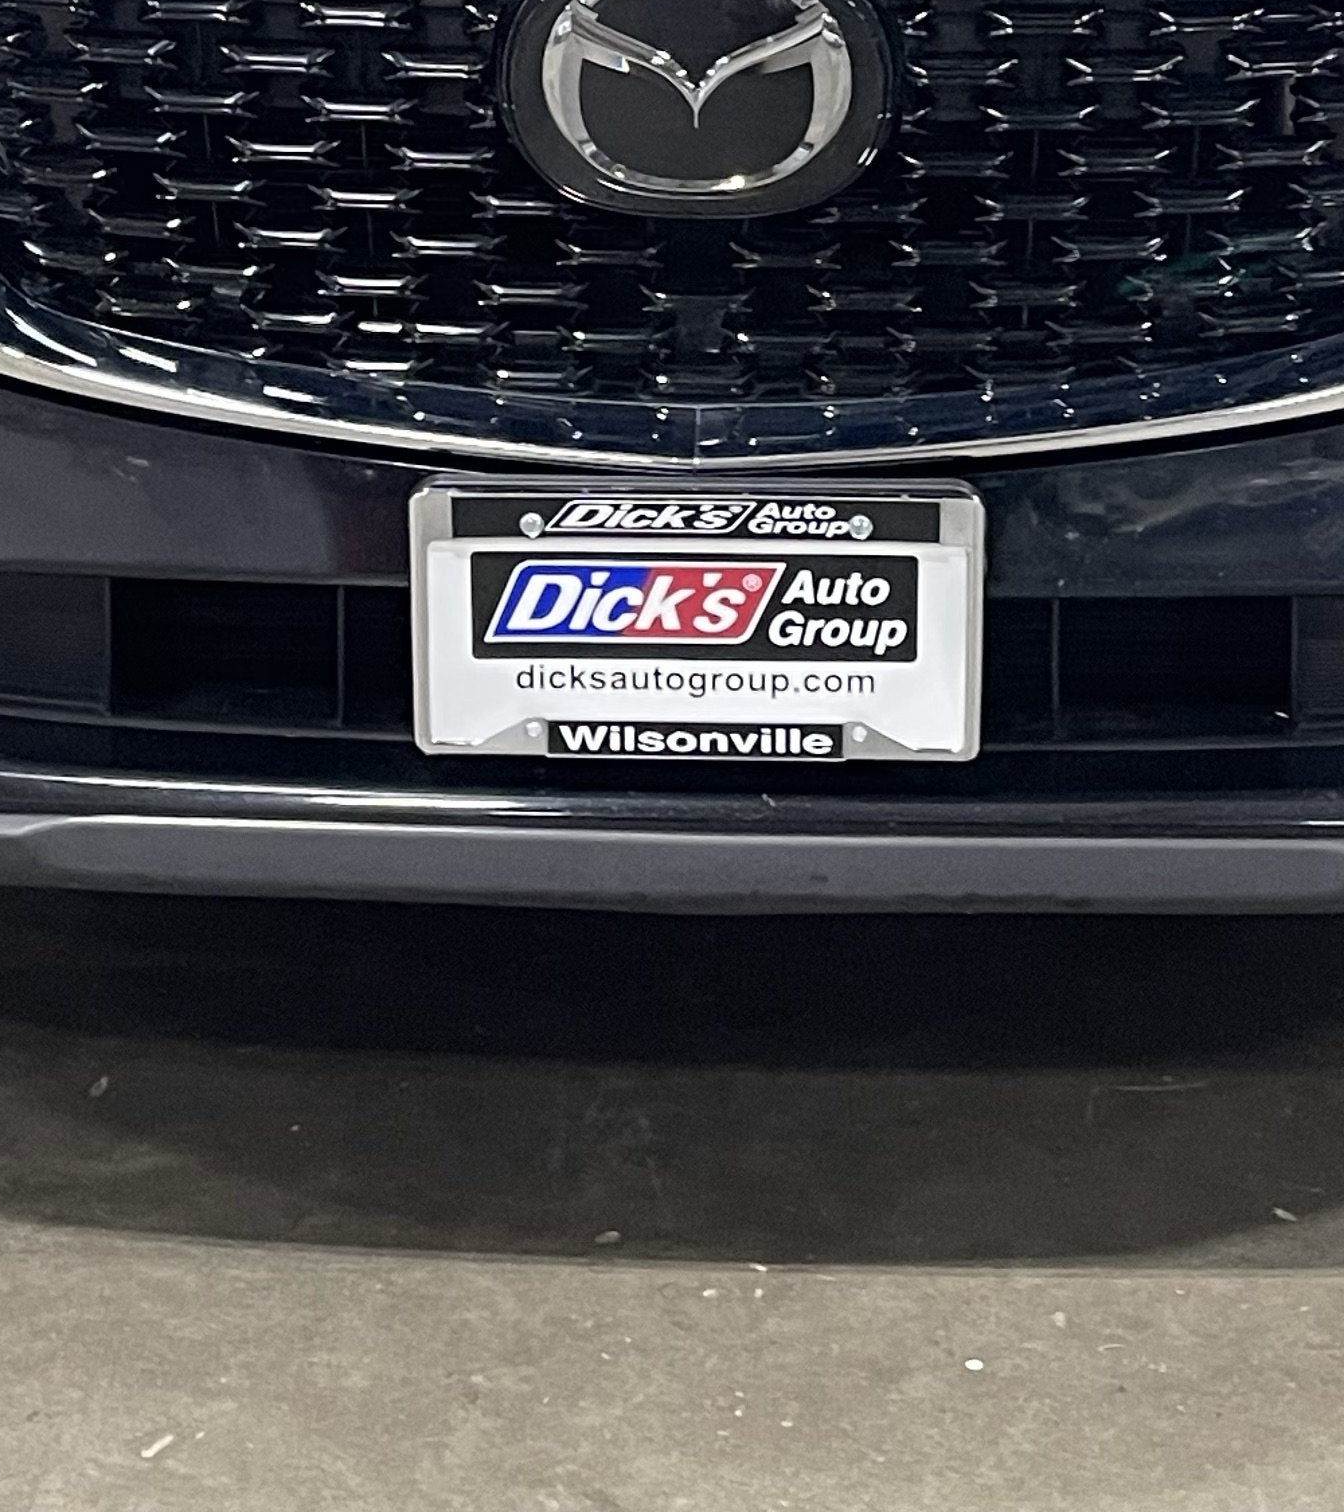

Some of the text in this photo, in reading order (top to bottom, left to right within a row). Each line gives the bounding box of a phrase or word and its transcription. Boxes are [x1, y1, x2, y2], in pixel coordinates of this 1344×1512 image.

[756, 502, 837, 520] Auto
[747, 518, 851, 538] Group
[781, 569, 892, 607] Auto
[768, 610, 908, 655] Group
[515, 664, 876, 697] dicksautogroup.com
[558, 724, 834, 755] Wilsonville
